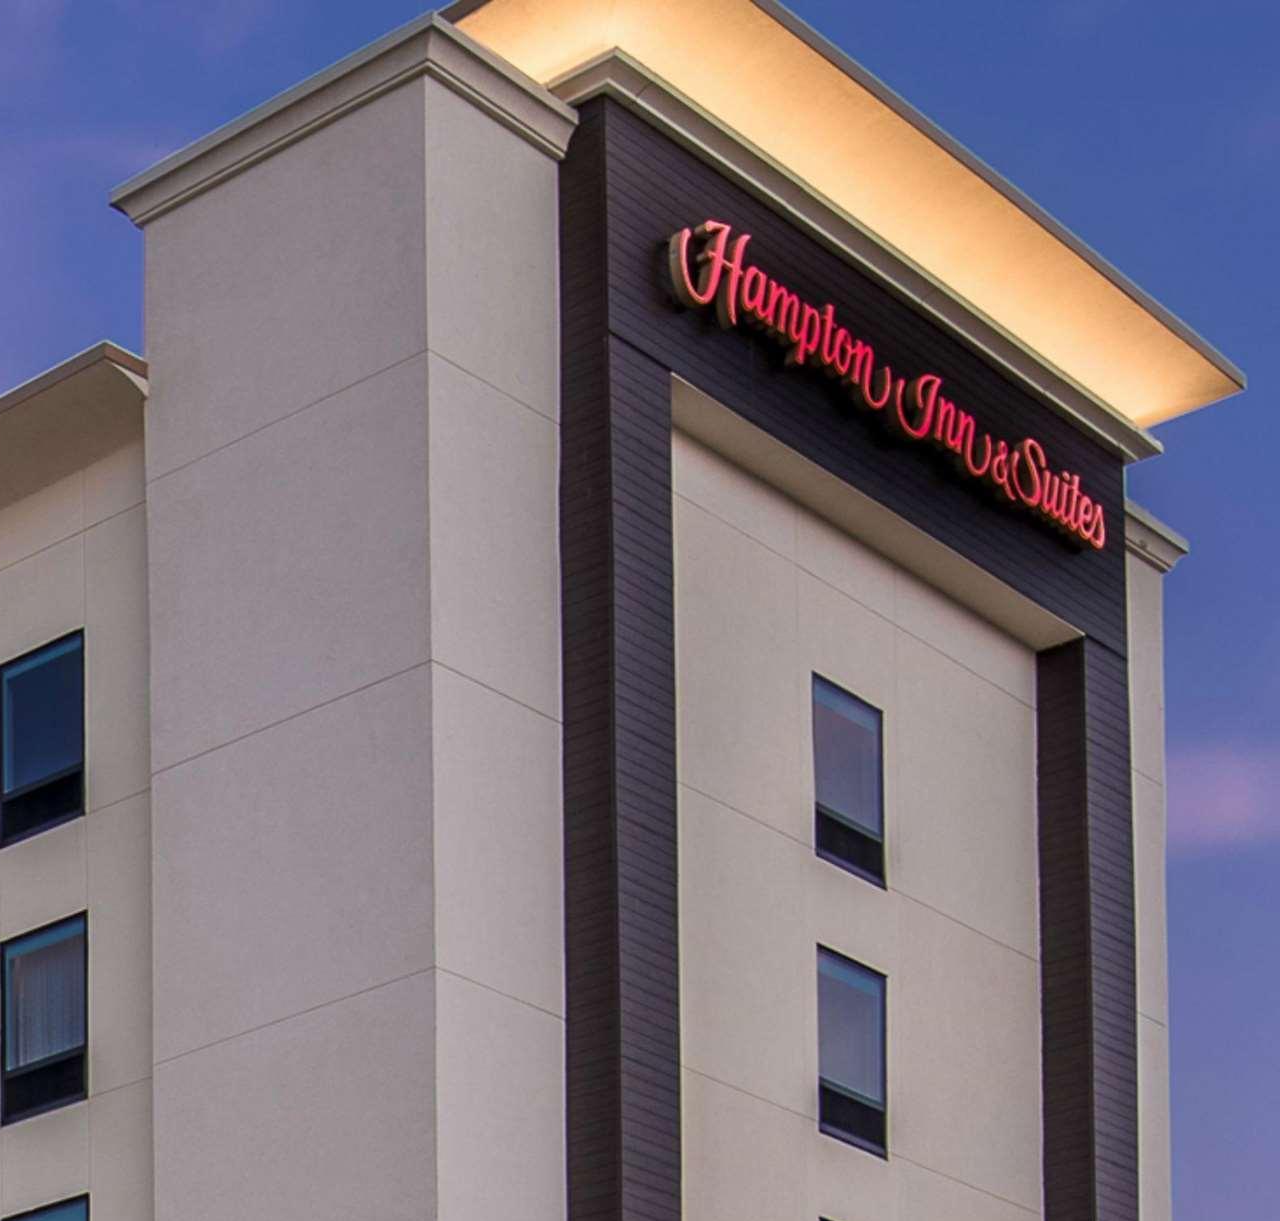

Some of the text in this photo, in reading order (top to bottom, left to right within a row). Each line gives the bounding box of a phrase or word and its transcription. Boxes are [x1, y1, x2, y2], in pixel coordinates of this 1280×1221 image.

[671, 219, 1106, 550] Hampton Inn & Suites
